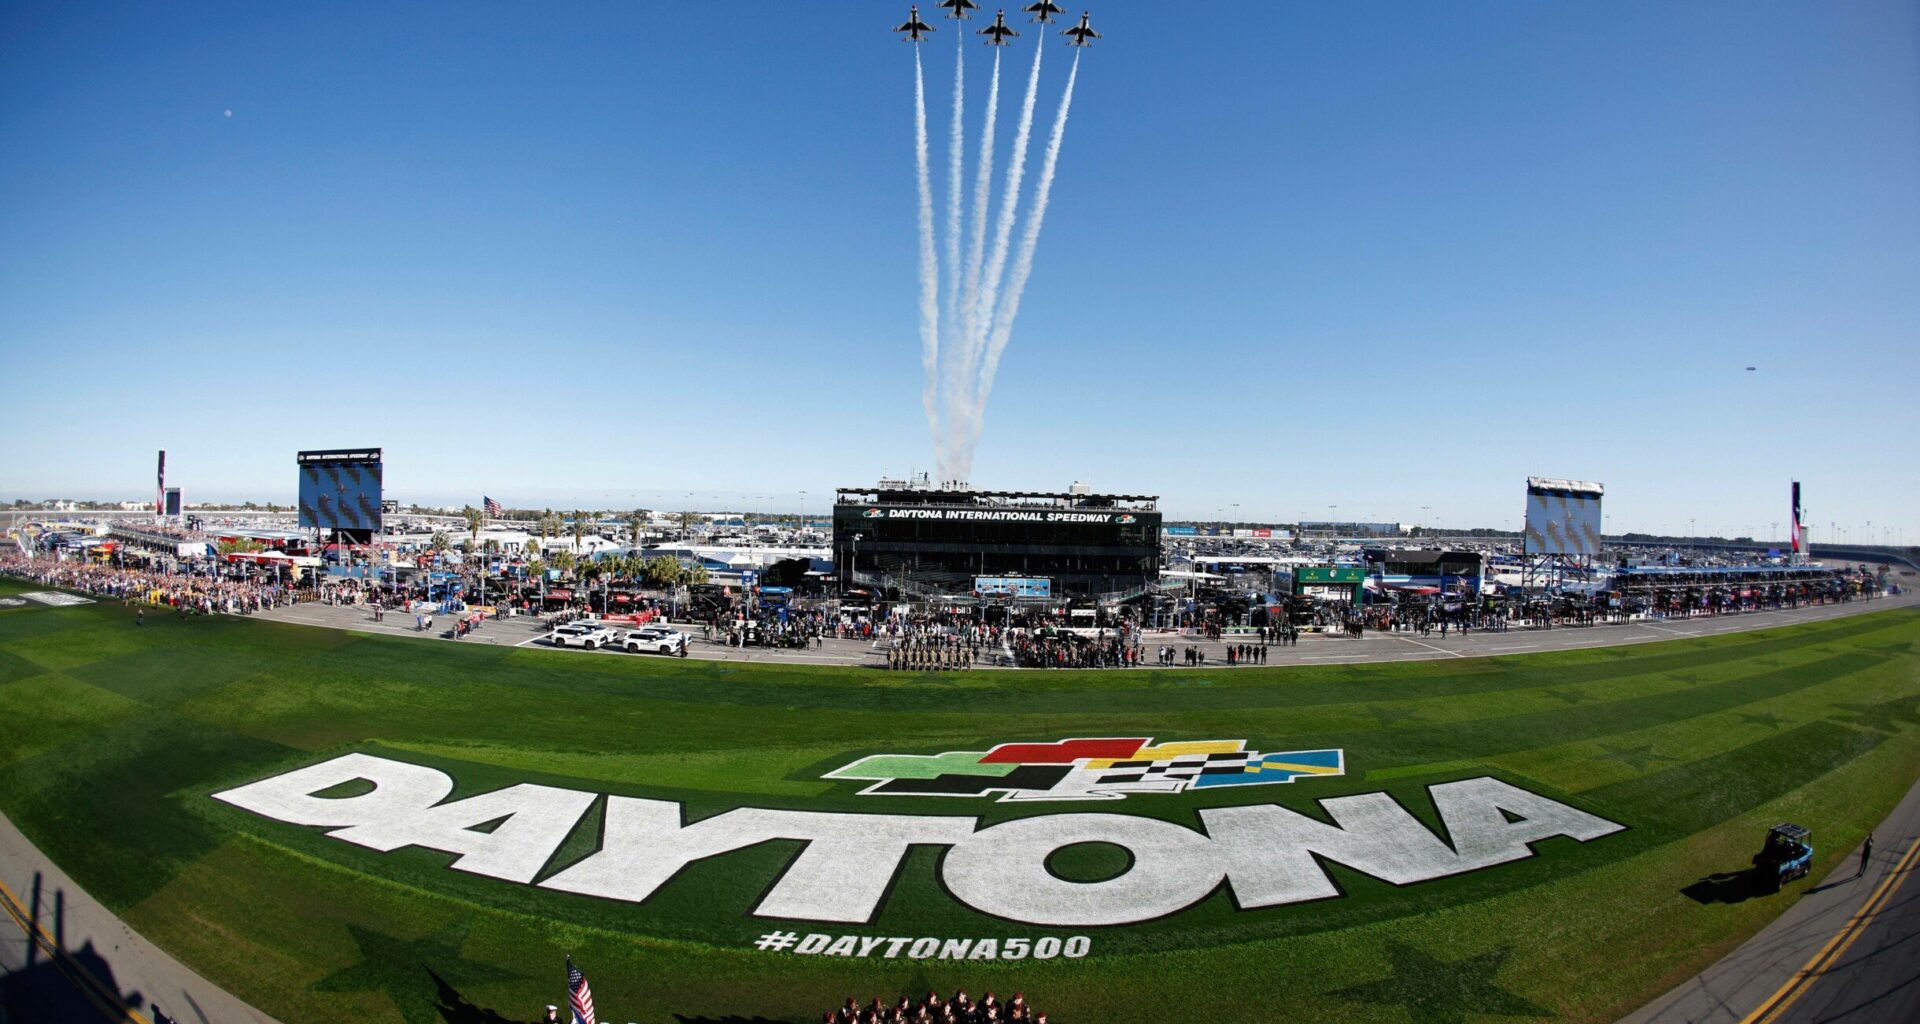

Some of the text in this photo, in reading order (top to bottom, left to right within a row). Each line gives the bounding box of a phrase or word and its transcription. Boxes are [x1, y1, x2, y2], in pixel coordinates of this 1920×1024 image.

[889, 509, 1112, 523] DAYTONA INTERNATIONAL SPEEDWAY
[211, 752, 1626, 925] DAYTONA
[754, 930, 1092, 960] #DAYTONA500
